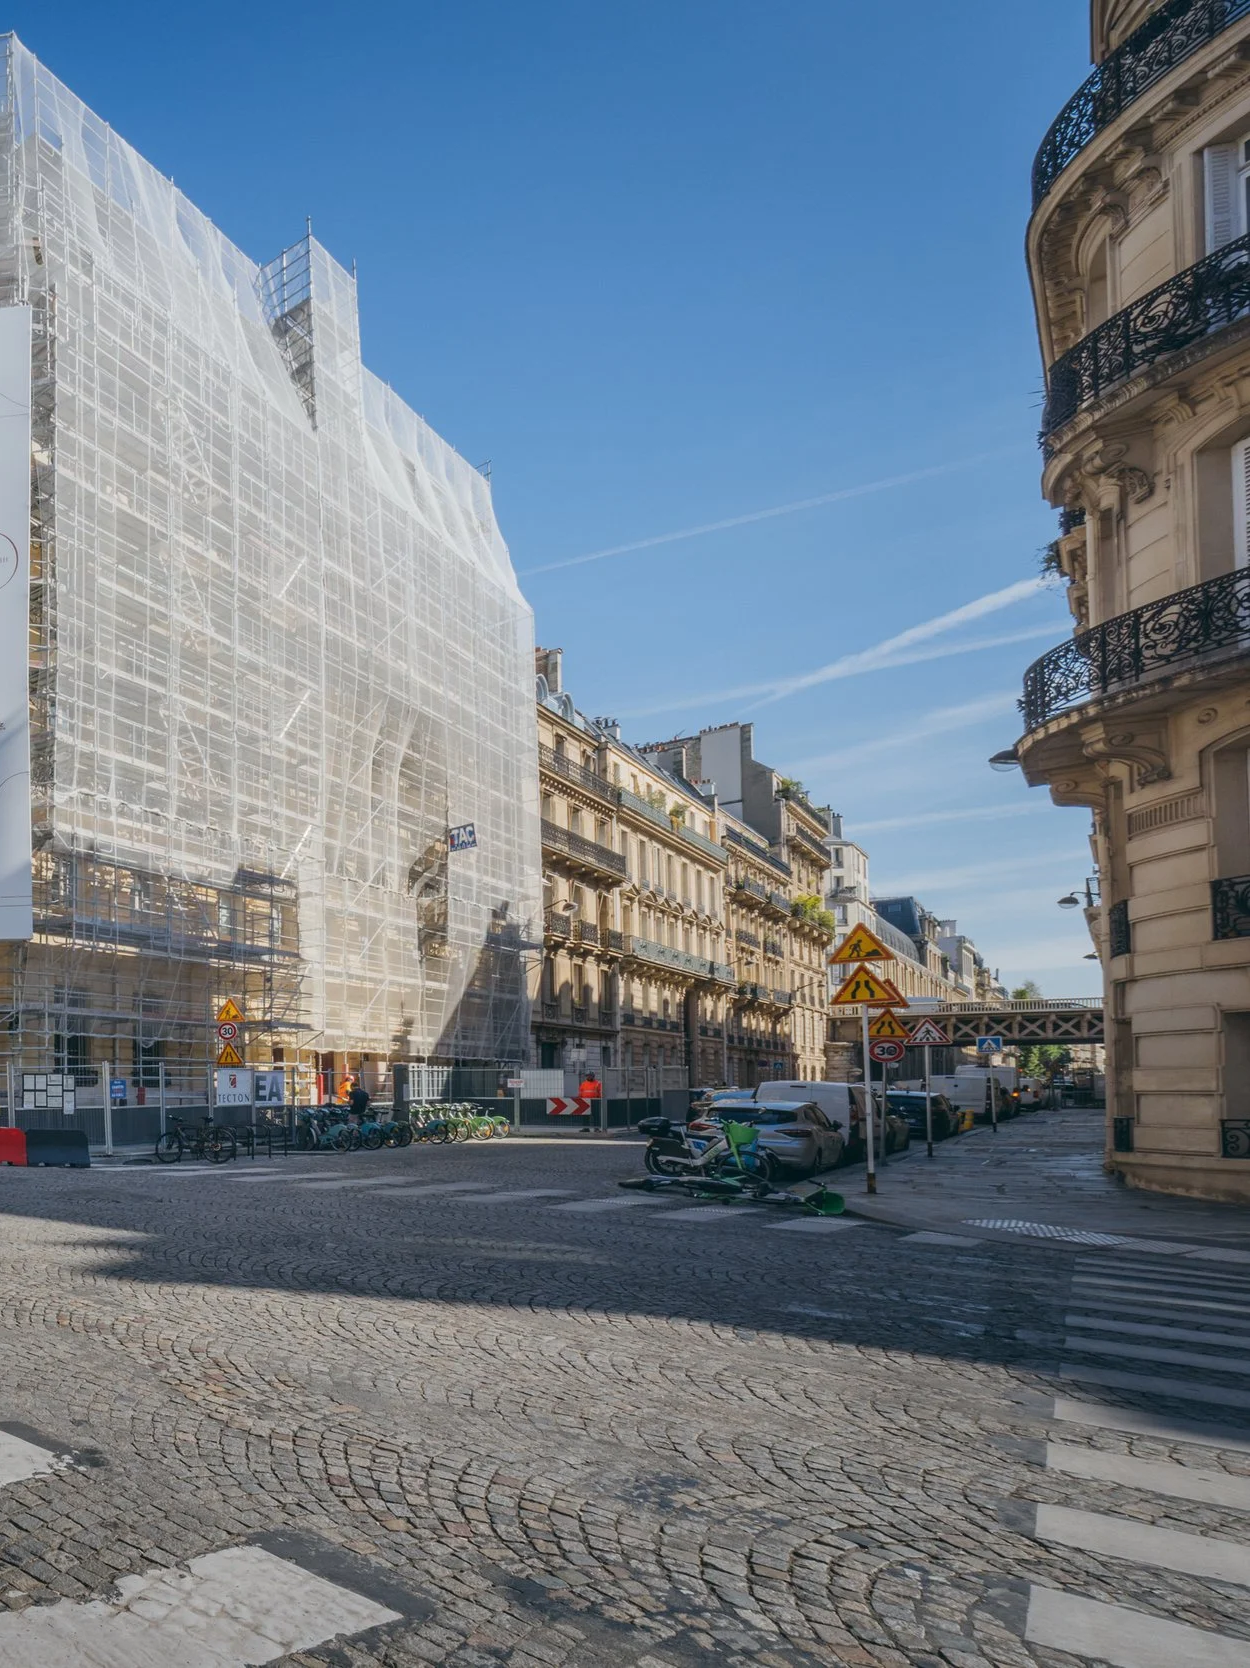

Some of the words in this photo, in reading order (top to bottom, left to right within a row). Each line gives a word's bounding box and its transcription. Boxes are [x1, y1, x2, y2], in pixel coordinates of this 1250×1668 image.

[222, 1027, 233, 1035] 30
[876, 1045, 898, 1056] 30
[255, 1075, 282, 1101] EA
[218, 1093, 250, 1103] TECTON
